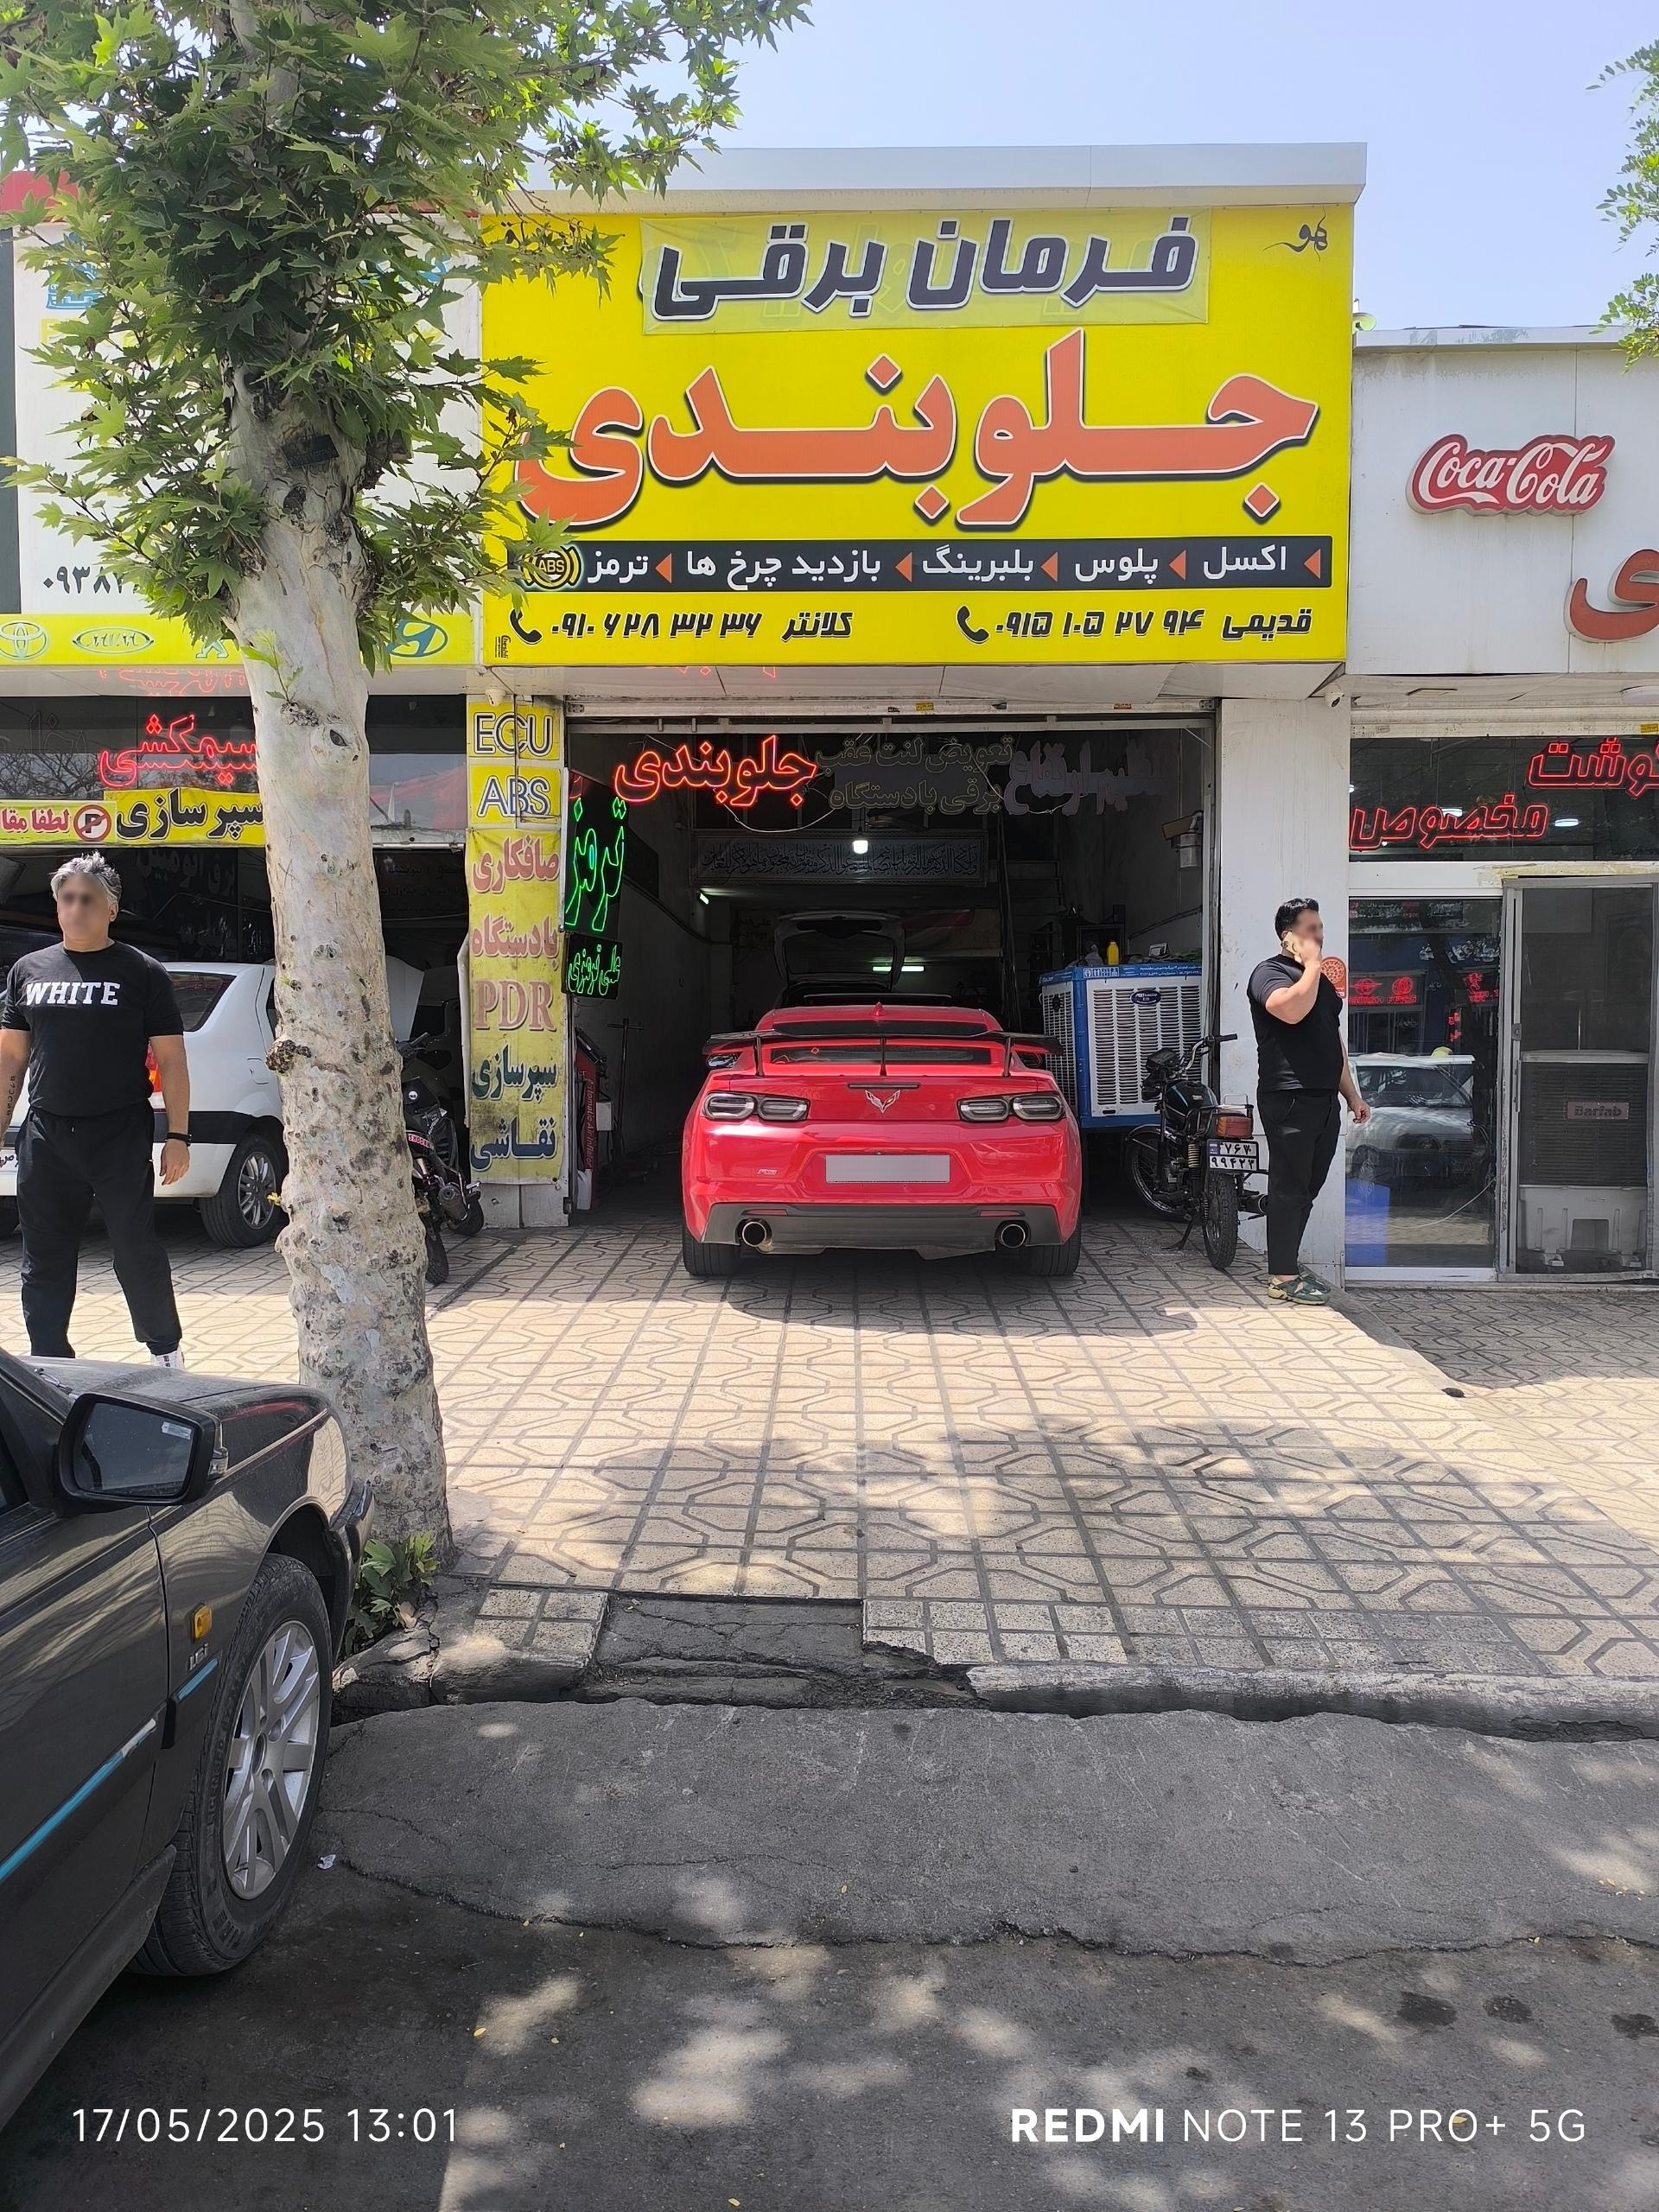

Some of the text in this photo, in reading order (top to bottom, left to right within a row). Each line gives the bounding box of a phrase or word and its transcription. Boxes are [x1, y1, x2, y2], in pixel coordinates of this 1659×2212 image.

[652, 214, 1199, 321] فرمان برقی
[517, 329, 1320, 529] جلوبندی
[1418, 440, 1607, 505] Coca-Cola
[538, 559, 566, 573] ABS
[587, 545, 1287, 590] اکسل پلوس بلبرینگ بازدید چرخ ها ترمز
[551, 612, 854, 643] کلانتر ۰۹۱۰ ۶۲۸ ۳۲ ۳۶
[995, 607, 1313, 641] قدیمی ۰۹۱۵ ۱۰۵ ۲۷ ۹۴
[474, 711, 554, 758] ECU
[815, 736, 1014, 775] تعویض لنت عقب
[614, 734, 818, 807] جلوبندی
[1527, 736, 1659, 798] وشت
[31, 809, 70, 834] لطفا
[117, 787, 264, 841] سپر سازی
[476, 774, 552, 818] ABS
[939, 778, 1003, 815] برقی
[1349, 793, 1549, 850] مخصوص
[472, 835, 560, 894] صافکاری
[565, 796, 627, 932] ترمز
[25, 982, 121, 1006] WHITE
[474, 980, 557, 1032] PDR
[470, 1114, 558, 1171] نقاشی
